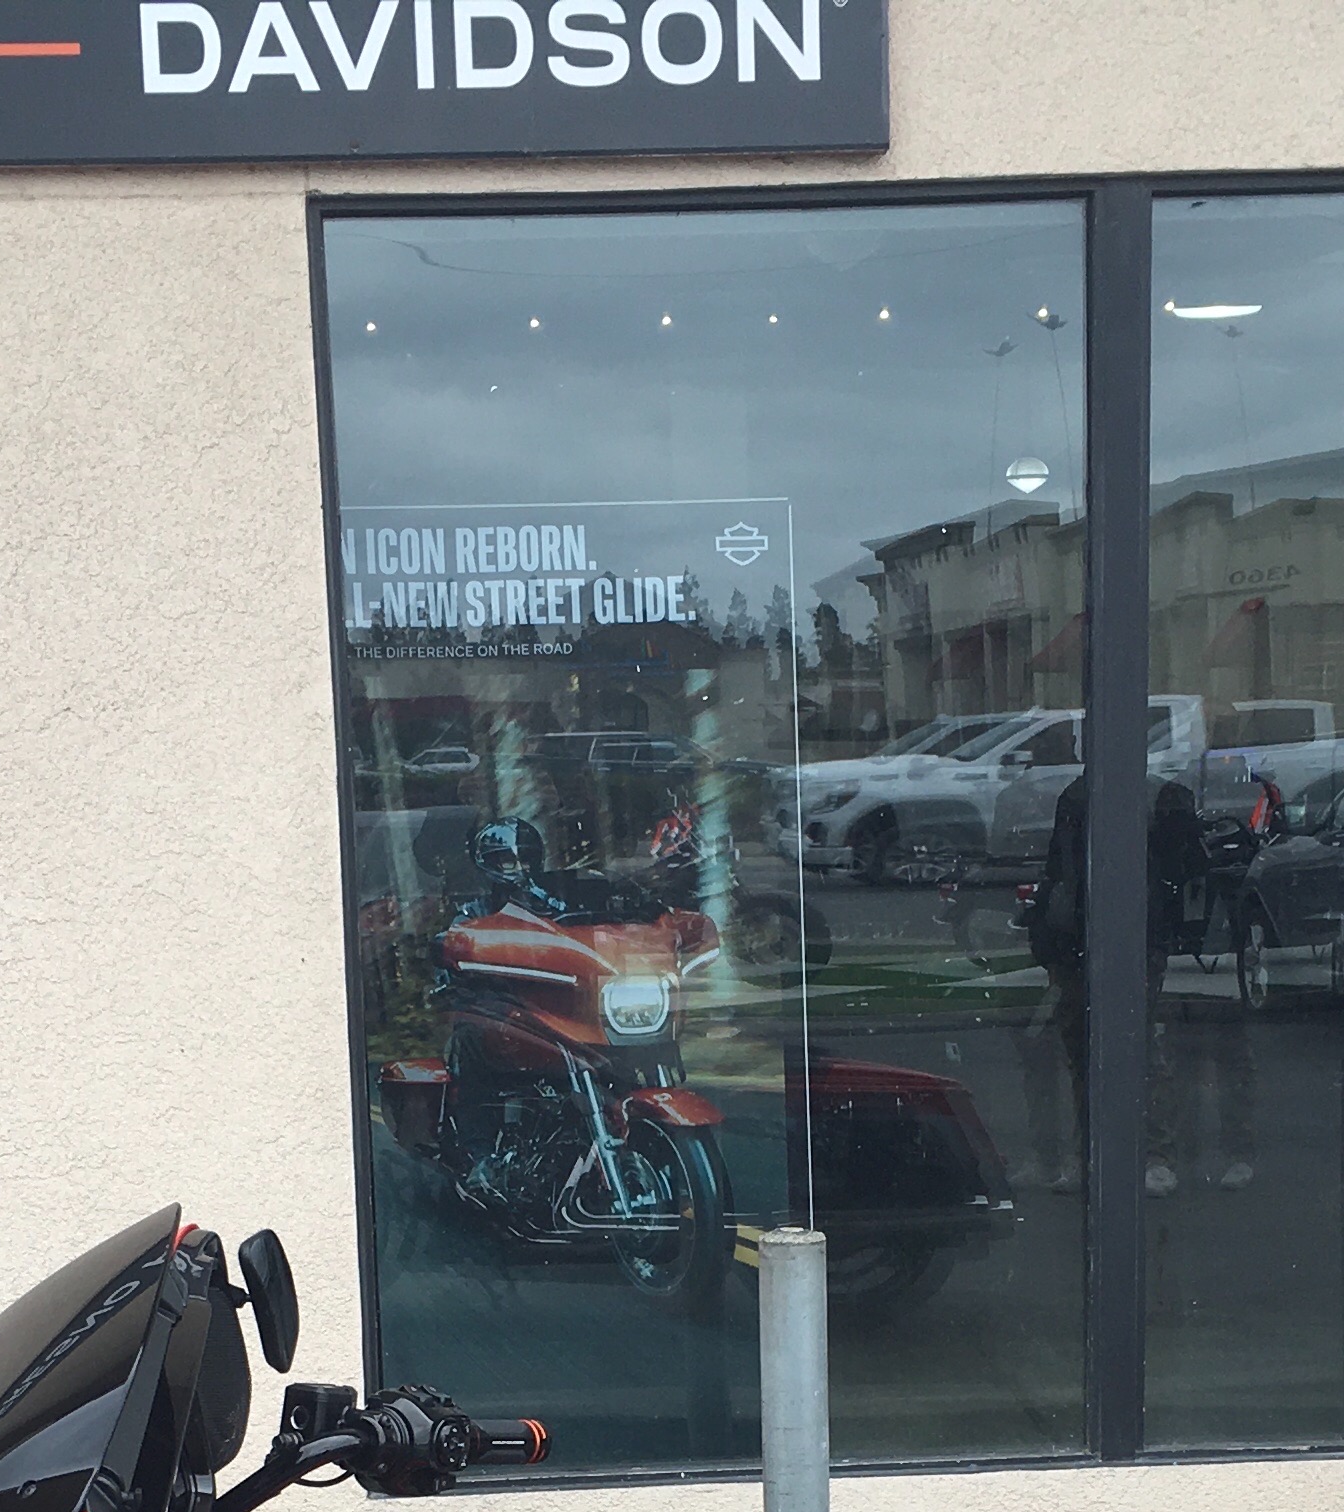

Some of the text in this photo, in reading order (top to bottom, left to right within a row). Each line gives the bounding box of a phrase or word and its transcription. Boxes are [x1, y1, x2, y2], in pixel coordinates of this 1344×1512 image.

[139, 0, 821, 95] DAVIDSON
[341, 524, 597, 575] N ICON REBORN.
[345, 575, 697, 628] L-NEW STREET GLIDE.
[354, 643, 573, 659] THE DIFFERENCE ON THE ROAD
